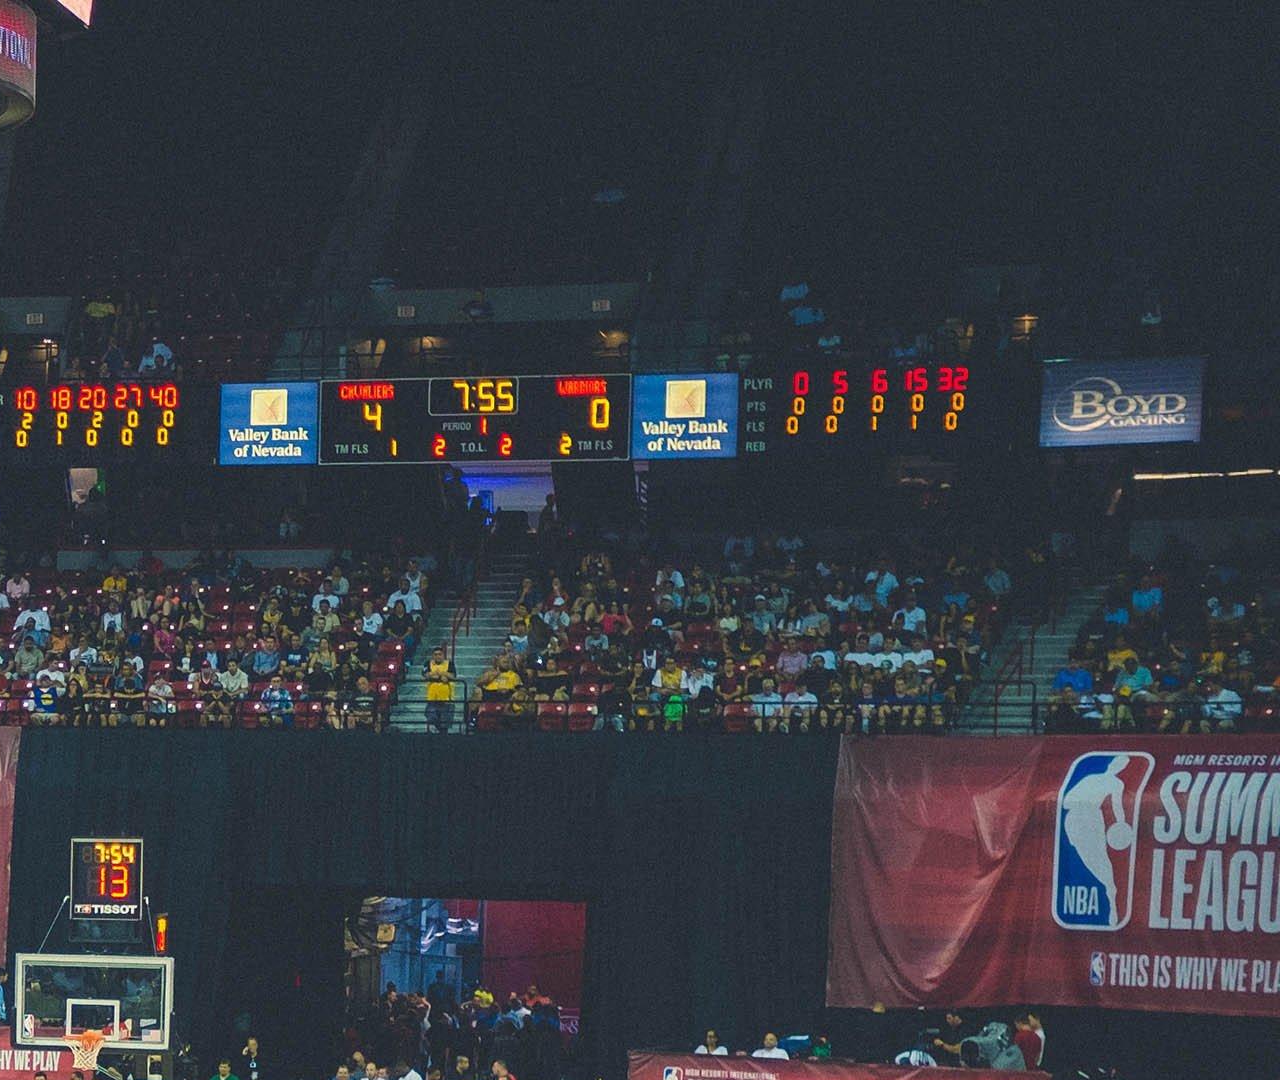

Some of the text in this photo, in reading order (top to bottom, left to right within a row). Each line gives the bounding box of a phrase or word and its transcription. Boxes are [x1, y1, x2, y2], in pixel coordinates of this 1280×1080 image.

[744, 367, 969, 395] PLYR 0 5 6 15 32
[16, 388, 37, 411] 10
[52, 388, 72, 410] 18
[79, 388, 106, 409] 20
[115, 387, 142, 408] 27
[150, 386, 178, 408] 40
[452, 380, 515, 412] 7:55
[747, 392, 965, 415] PTS 0 0 0 0 0
[1069, 390, 1187, 419] BOYD
[22, 412, 33, 430] 2
[57, 411, 68, 429] 0
[92, 411, 103, 428] 2
[127, 410, 139, 428] 0
[163, 410, 174, 427] 0
[363, 402, 382, 432] 4
[591, 397, 610, 429] 0
[746, 411, 958, 435] FLS 0 0 1 1 0
[1109, 414, 1186, 428] GAMING
[228, 427, 308, 443] Valley Bank
[442, 416, 488, 435] PERIOD 1
[642, 419, 728, 436] Valley Bank
[16, 430, 27, 447] 0
[56, 430, 62, 445] 1
[86, 429, 97, 446] 0
[121, 428, 133, 446] 0
[157, 428, 168, 445] 0
[334, 438, 399, 456] TM FLS 1
[434, 436, 447, 457] 2
[501, 436, 513, 456] 2
[559, 433, 613, 455] 2 TM FLS
[647, 437, 721, 451] of Nevada
[746, 441, 766, 452] REB
[234, 444, 301, 457] of Nevada
[1174, 754, 1204, 766] MGM
[1208, 754, 1267, 766] RESORTS
[95, 843, 135, 864] 7:54
[100, 866, 129, 898] 13
[92, 904, 138, 914] TISSOT
[1063, 885, 1099, 916] NBA
[1109, 953, 1247, 991] THIS IS WHY WE
[14, 1049, 32, 1071] WE
[33, 1050, 60, 1072] PLAY
